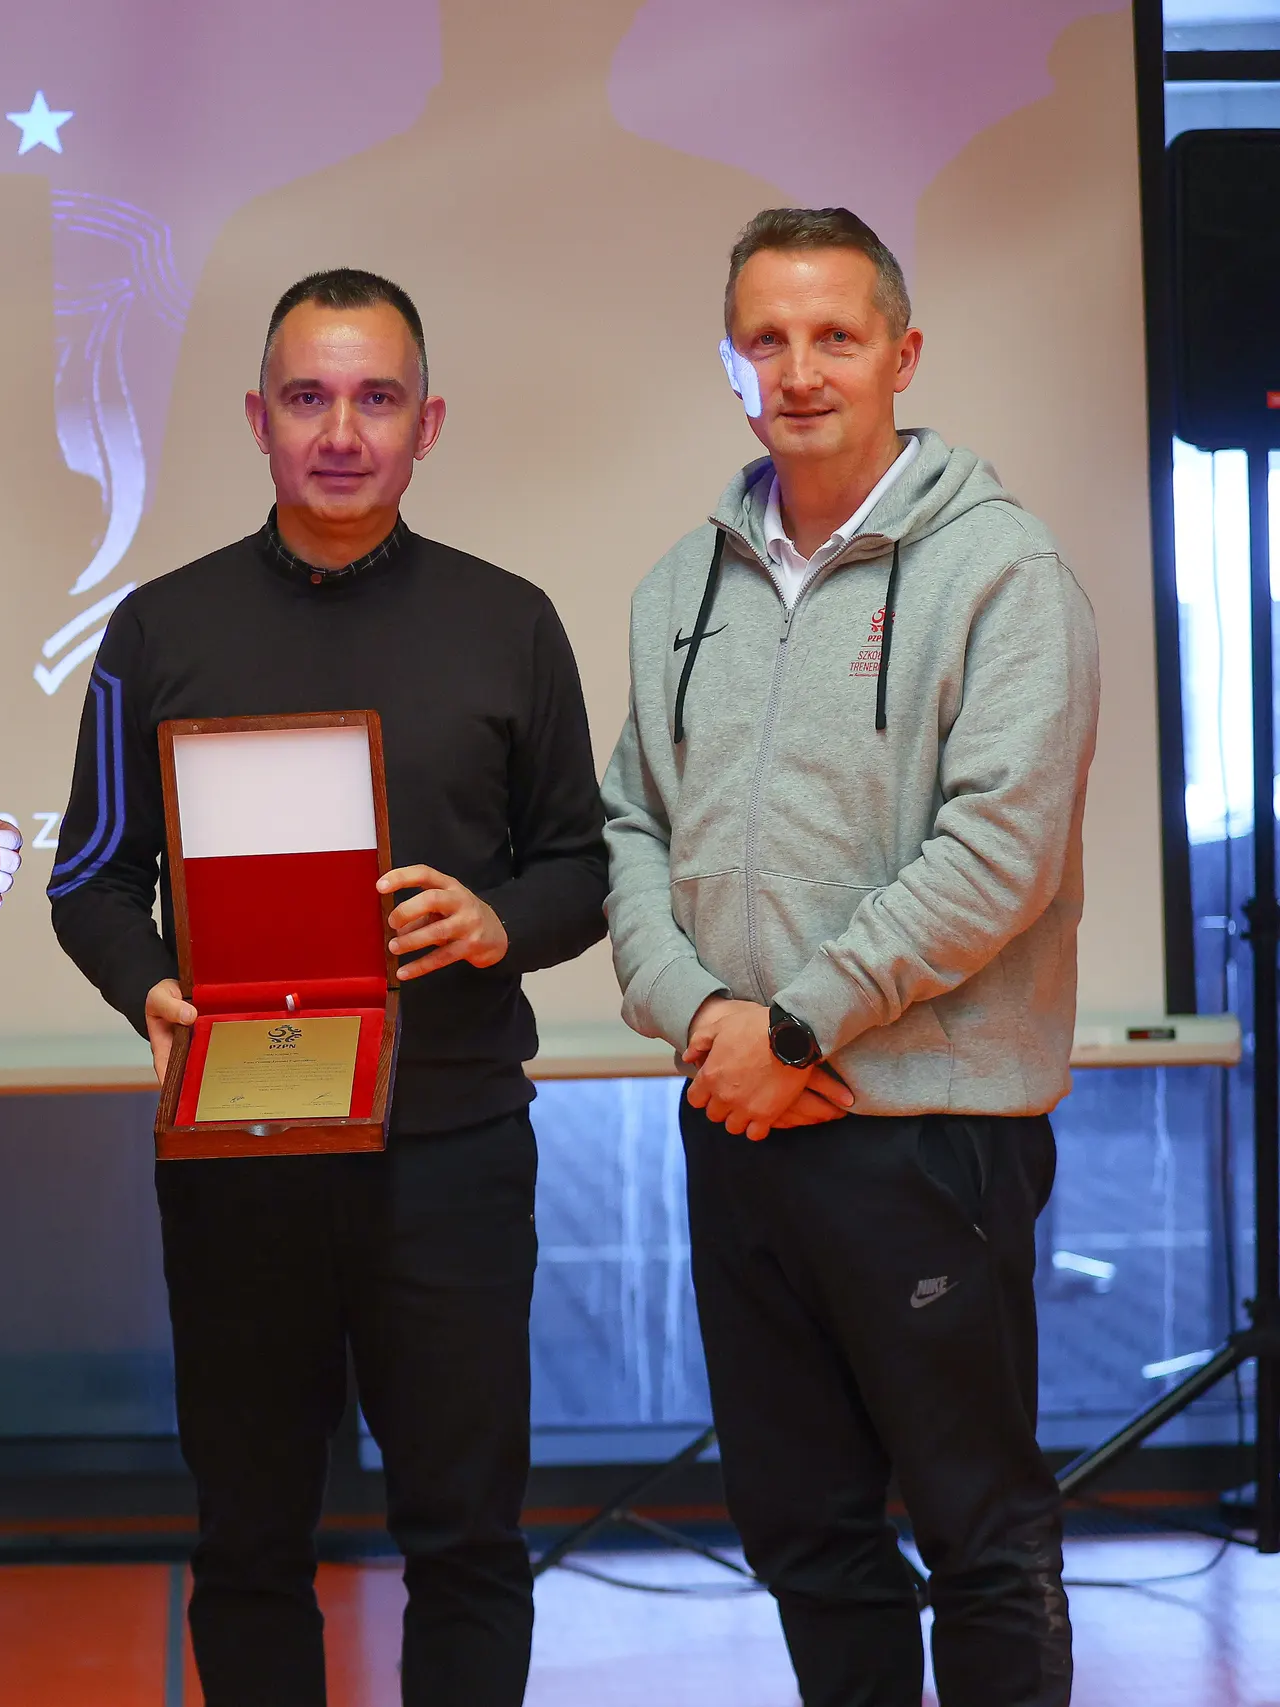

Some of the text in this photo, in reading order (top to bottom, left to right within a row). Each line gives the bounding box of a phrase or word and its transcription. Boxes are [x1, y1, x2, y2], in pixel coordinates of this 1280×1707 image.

[857, 650, 882, 660] SZKOŁ
[850, 662, 891, 671] TRENER
[917, 1275, 948, 1296] NIKE
